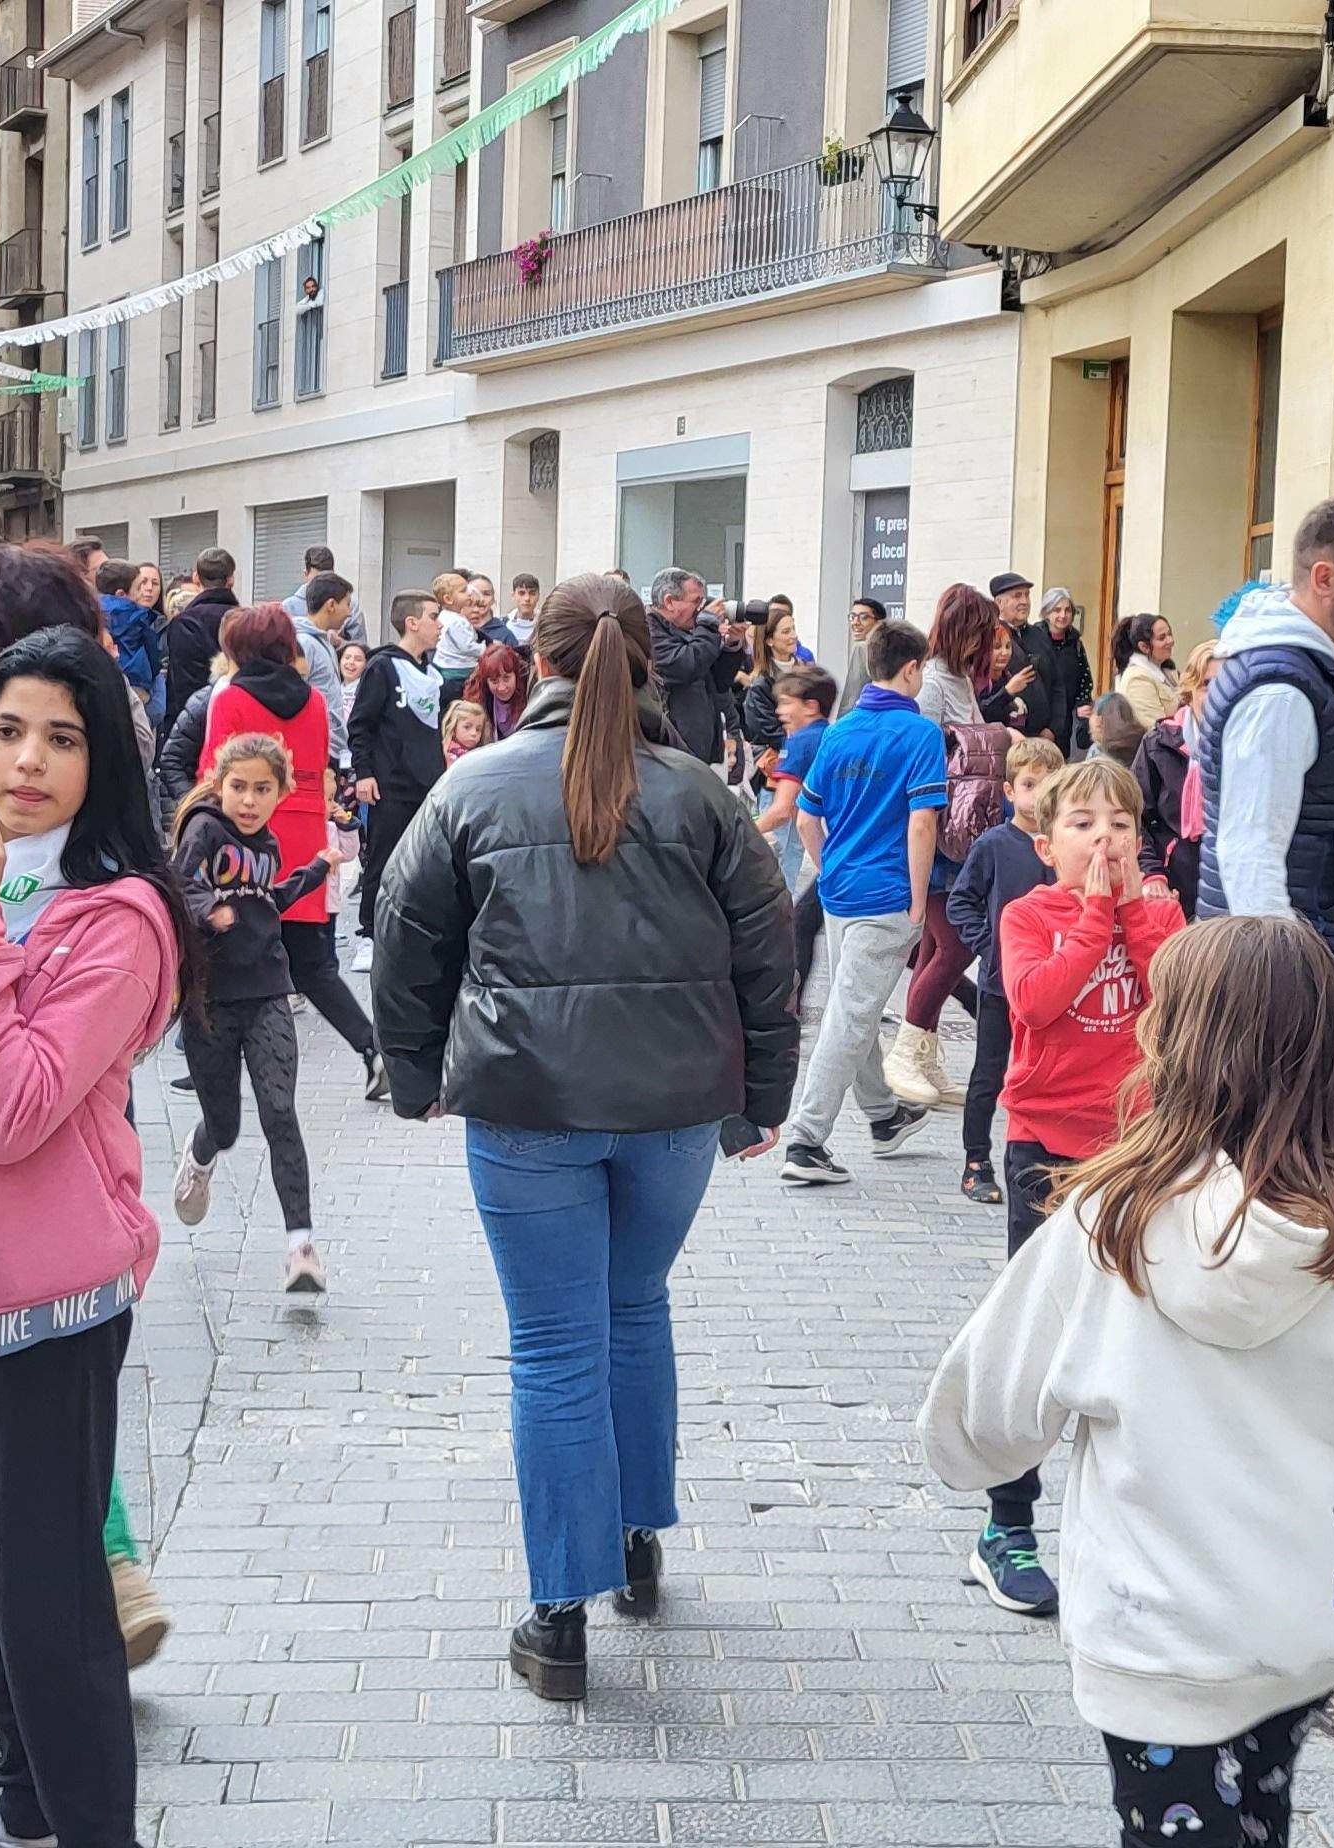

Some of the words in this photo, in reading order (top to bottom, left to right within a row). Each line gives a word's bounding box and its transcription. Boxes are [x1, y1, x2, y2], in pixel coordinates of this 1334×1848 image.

[875, 516, 886, 532] Te
[871, 544, 881, 559] el
[881, 543, 906, 559] local
[870, 574, 892, 589] para
[893, 570, 903, 586] tu
[52, 1286, 101, 1330] NIKE
[115, 1266, 139, 1307] NIK
